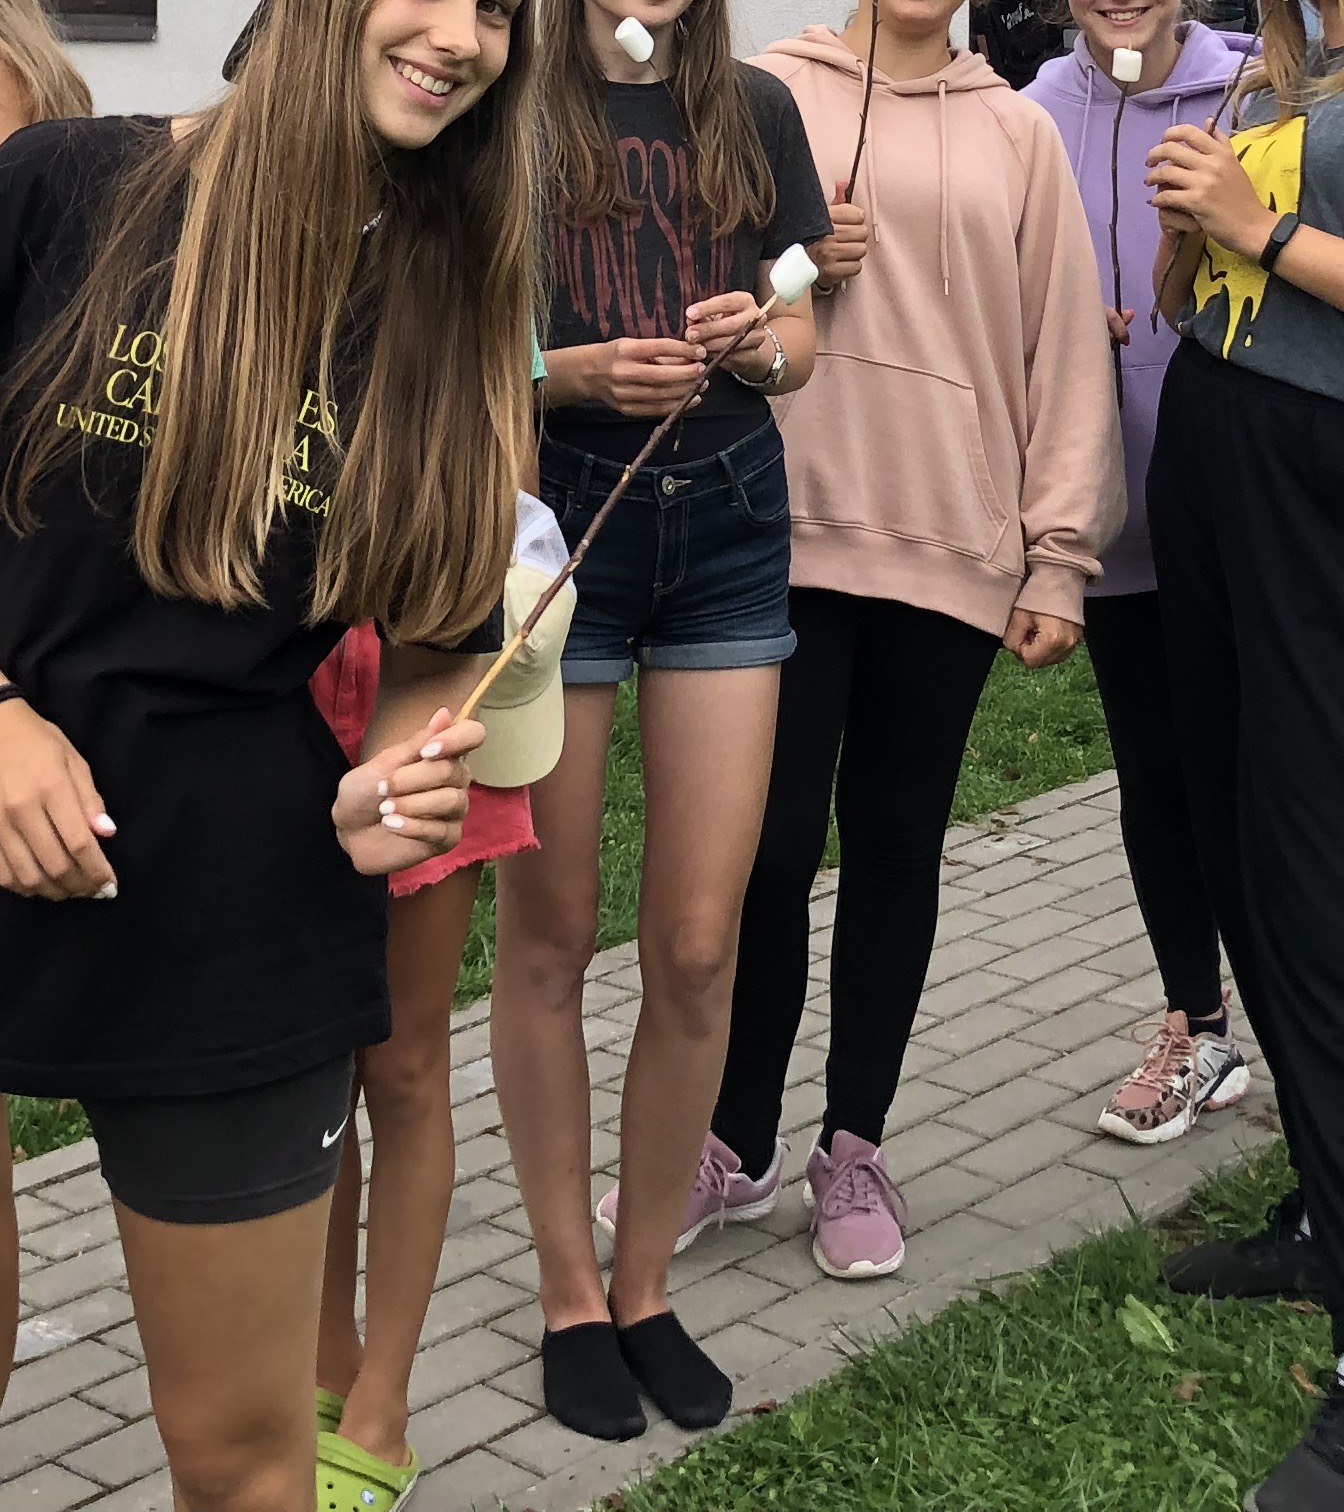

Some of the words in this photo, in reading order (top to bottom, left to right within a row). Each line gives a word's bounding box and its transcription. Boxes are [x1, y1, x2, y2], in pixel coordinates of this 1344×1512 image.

[107, 323, 164, 373] LO
[56, 402, 139, 444] UNITED
[281, 474, 331, 518] ERICA
